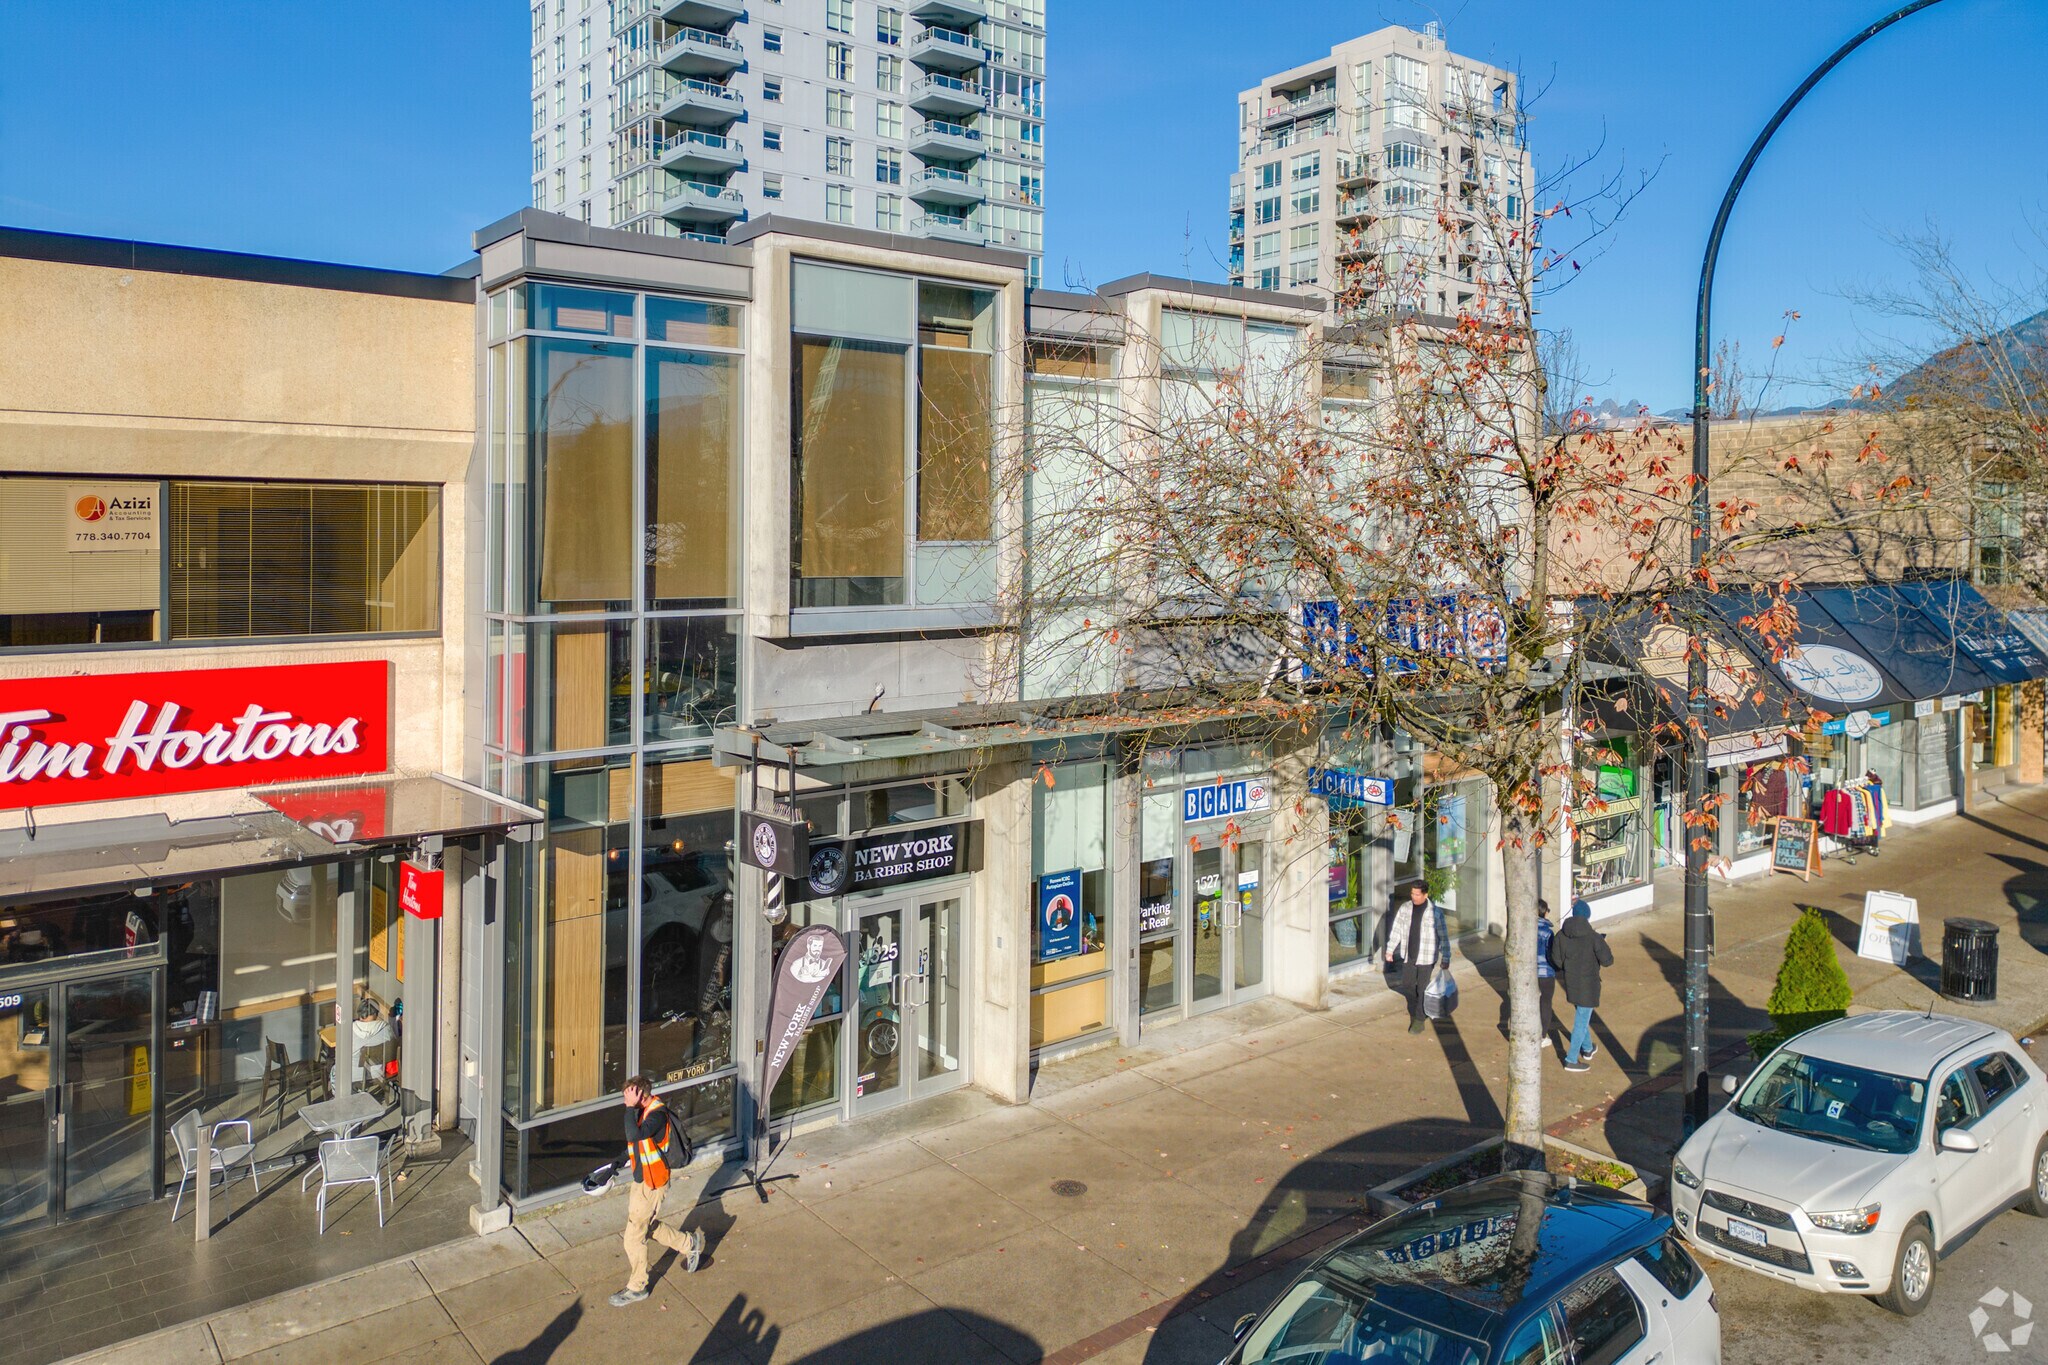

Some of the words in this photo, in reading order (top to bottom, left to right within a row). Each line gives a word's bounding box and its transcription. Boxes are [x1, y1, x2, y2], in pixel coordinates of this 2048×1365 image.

[109, 496, 152, 510] Azizi
[75, 531, 151, 541] 778.340.7704
[1832, 653, 1873, 682] Sky
[102, 698, 360, 776] Hortons
[1187, 785, 1245, 817] BCAA
[854, 843, 903, 867] NEW
[900, 834, 954, 859] YORK
[1777, 848, 1797, 858] FALL
[854, 862, 914, 883] BARBER
[916, 855, 954, 872] SHOP
[1195, 873, 1220, 891] 1527
[1149, 916, 1170, 930] Rear
[1868, 932, 1901, 947] OPEN
[809, 985, 822, 1009] SHOP
[770, 1037, 791, 1069] NEW
[784, 1003, 807, 1042] YORK
[667, 1070, 683, 1082] NEW
[686, 1065, 706, 1079] YORK
